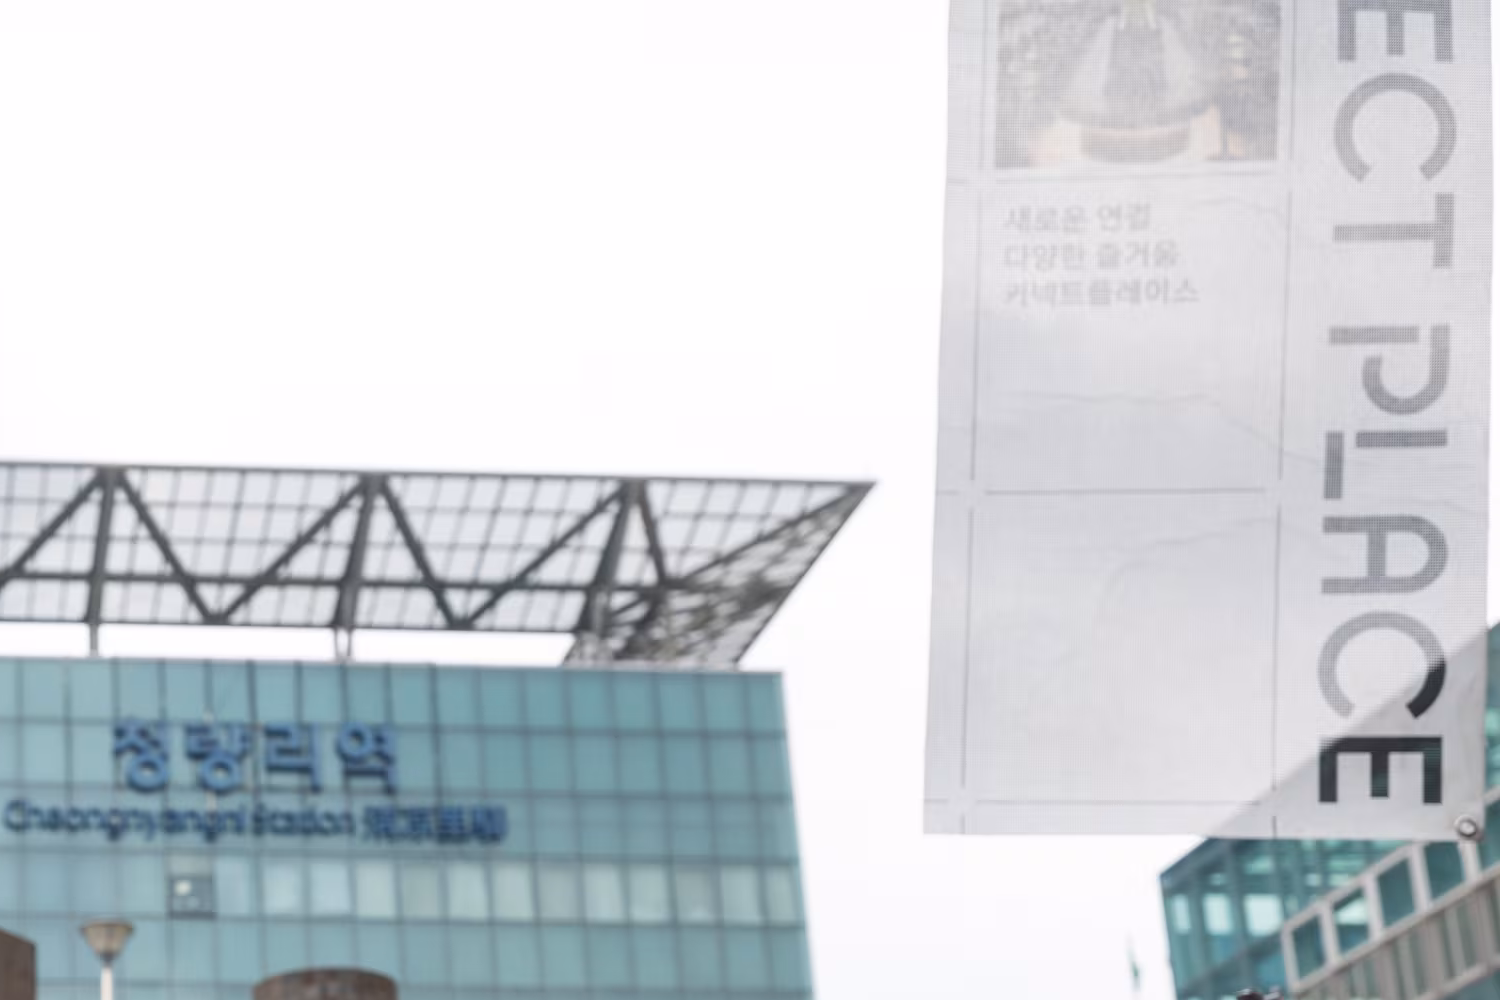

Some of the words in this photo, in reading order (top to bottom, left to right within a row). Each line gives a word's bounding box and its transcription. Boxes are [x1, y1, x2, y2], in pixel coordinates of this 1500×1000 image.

[1004, 205, 1089, 233] 새로운
[1003, 244, 1086, 273] 다양한
[1317, 324, 1451, 805] PLACE
